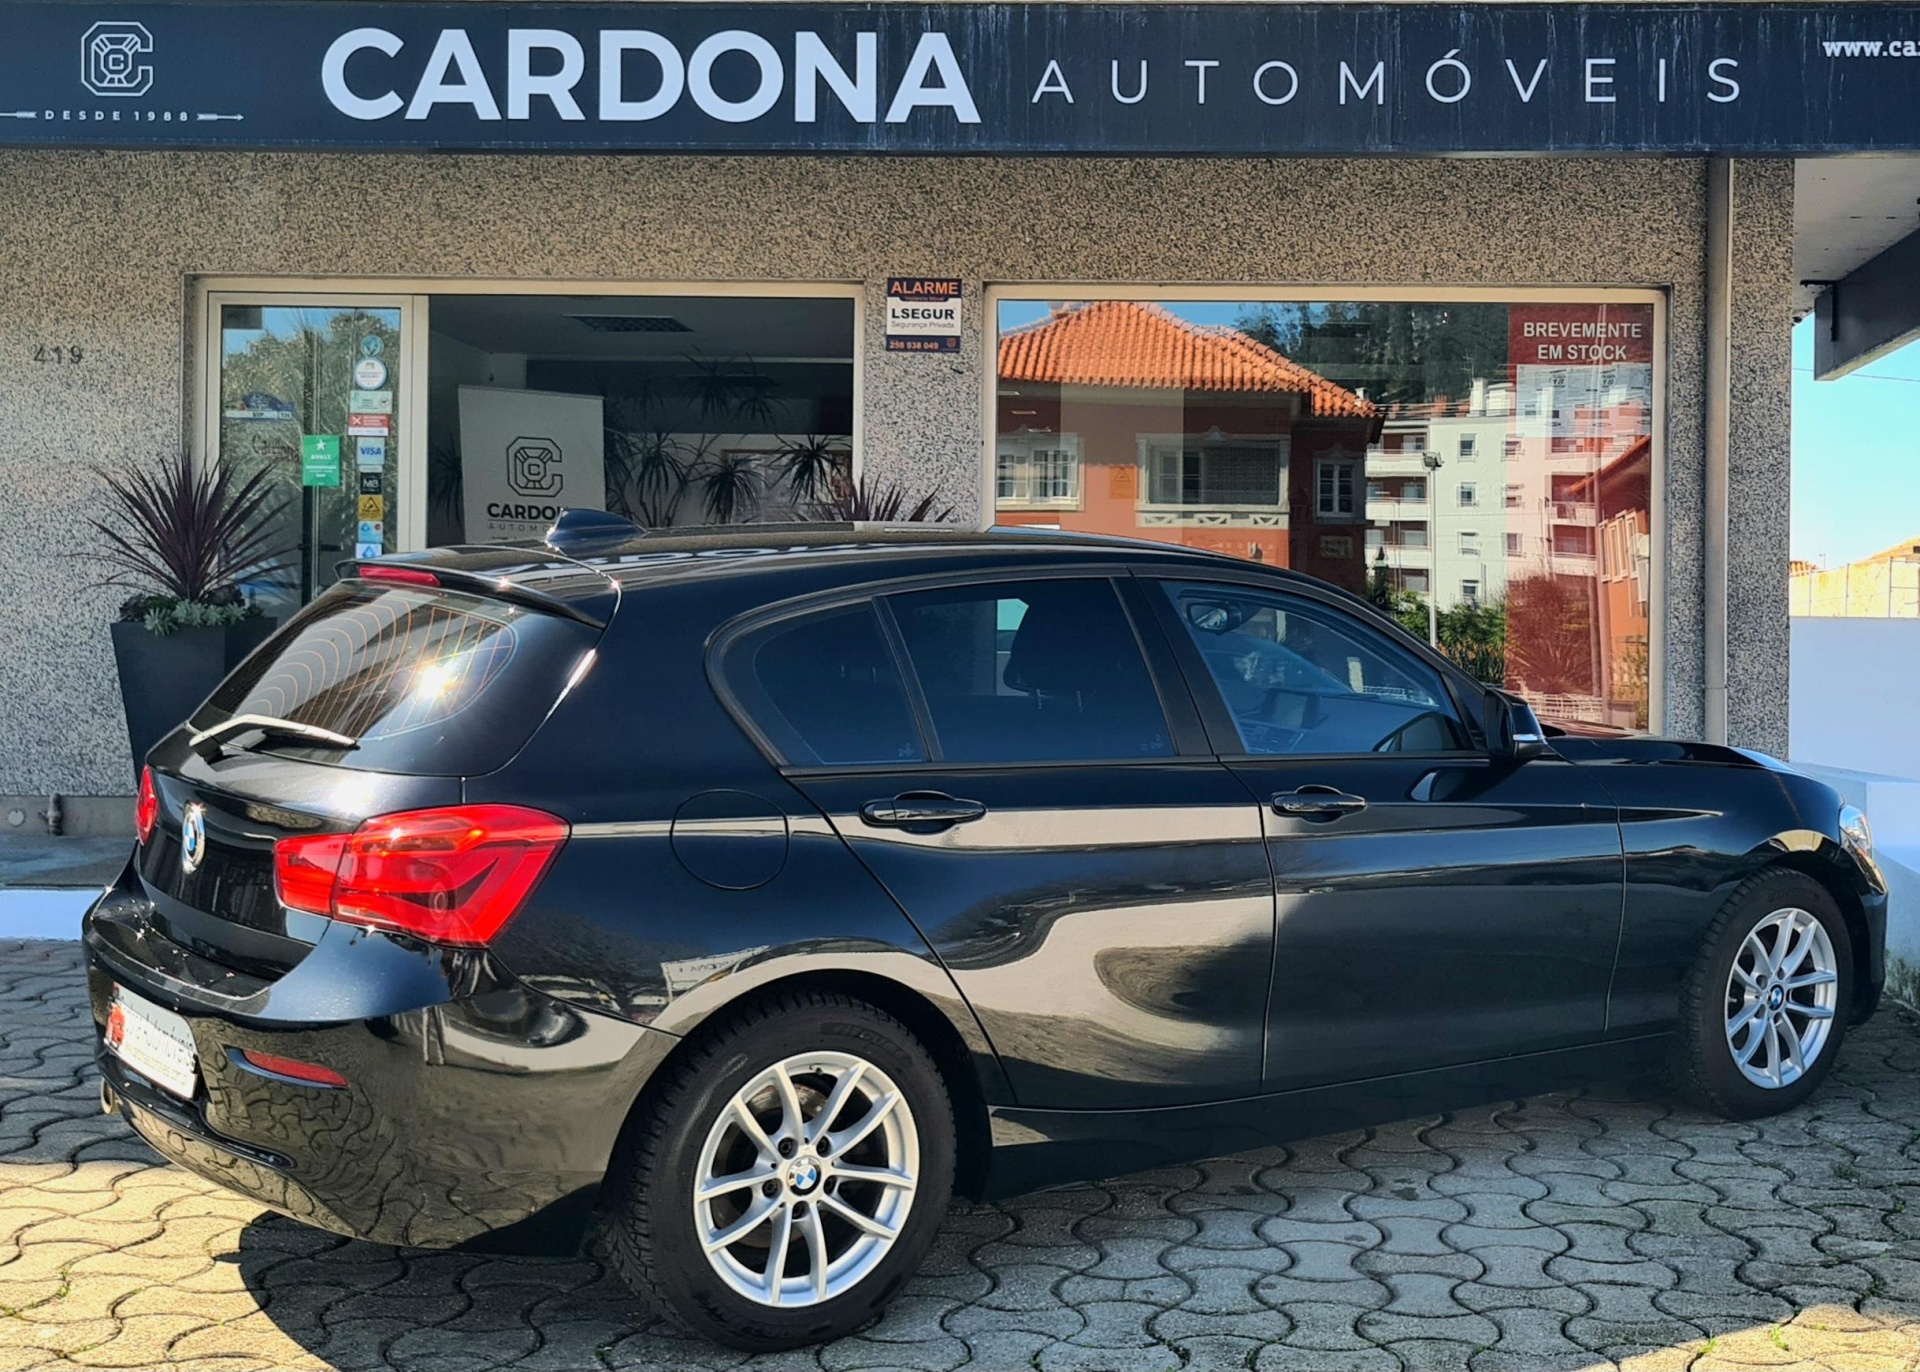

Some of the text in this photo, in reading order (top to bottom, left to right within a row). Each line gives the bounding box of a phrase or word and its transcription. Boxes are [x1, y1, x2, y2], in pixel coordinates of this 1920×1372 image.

[1822, 40, 1920, 57] www.ca
[321, 28, 1740, 123] CARDONA AUTOMÓVEIS
[45, 110, 188, 121] DESDE 1988
[891, 281, 958, 295] ALARME
[892, 308, 954, 320] LSEGUR
[891, 321, 954, 329] Segurança Privada
[1523, 322, 1642, 338] BREVEMENTE
[34, 345, 83, 364] 419
[1538, 344, 1627, 361] EM STOCK
[360, 447, 382, 455] VISA
